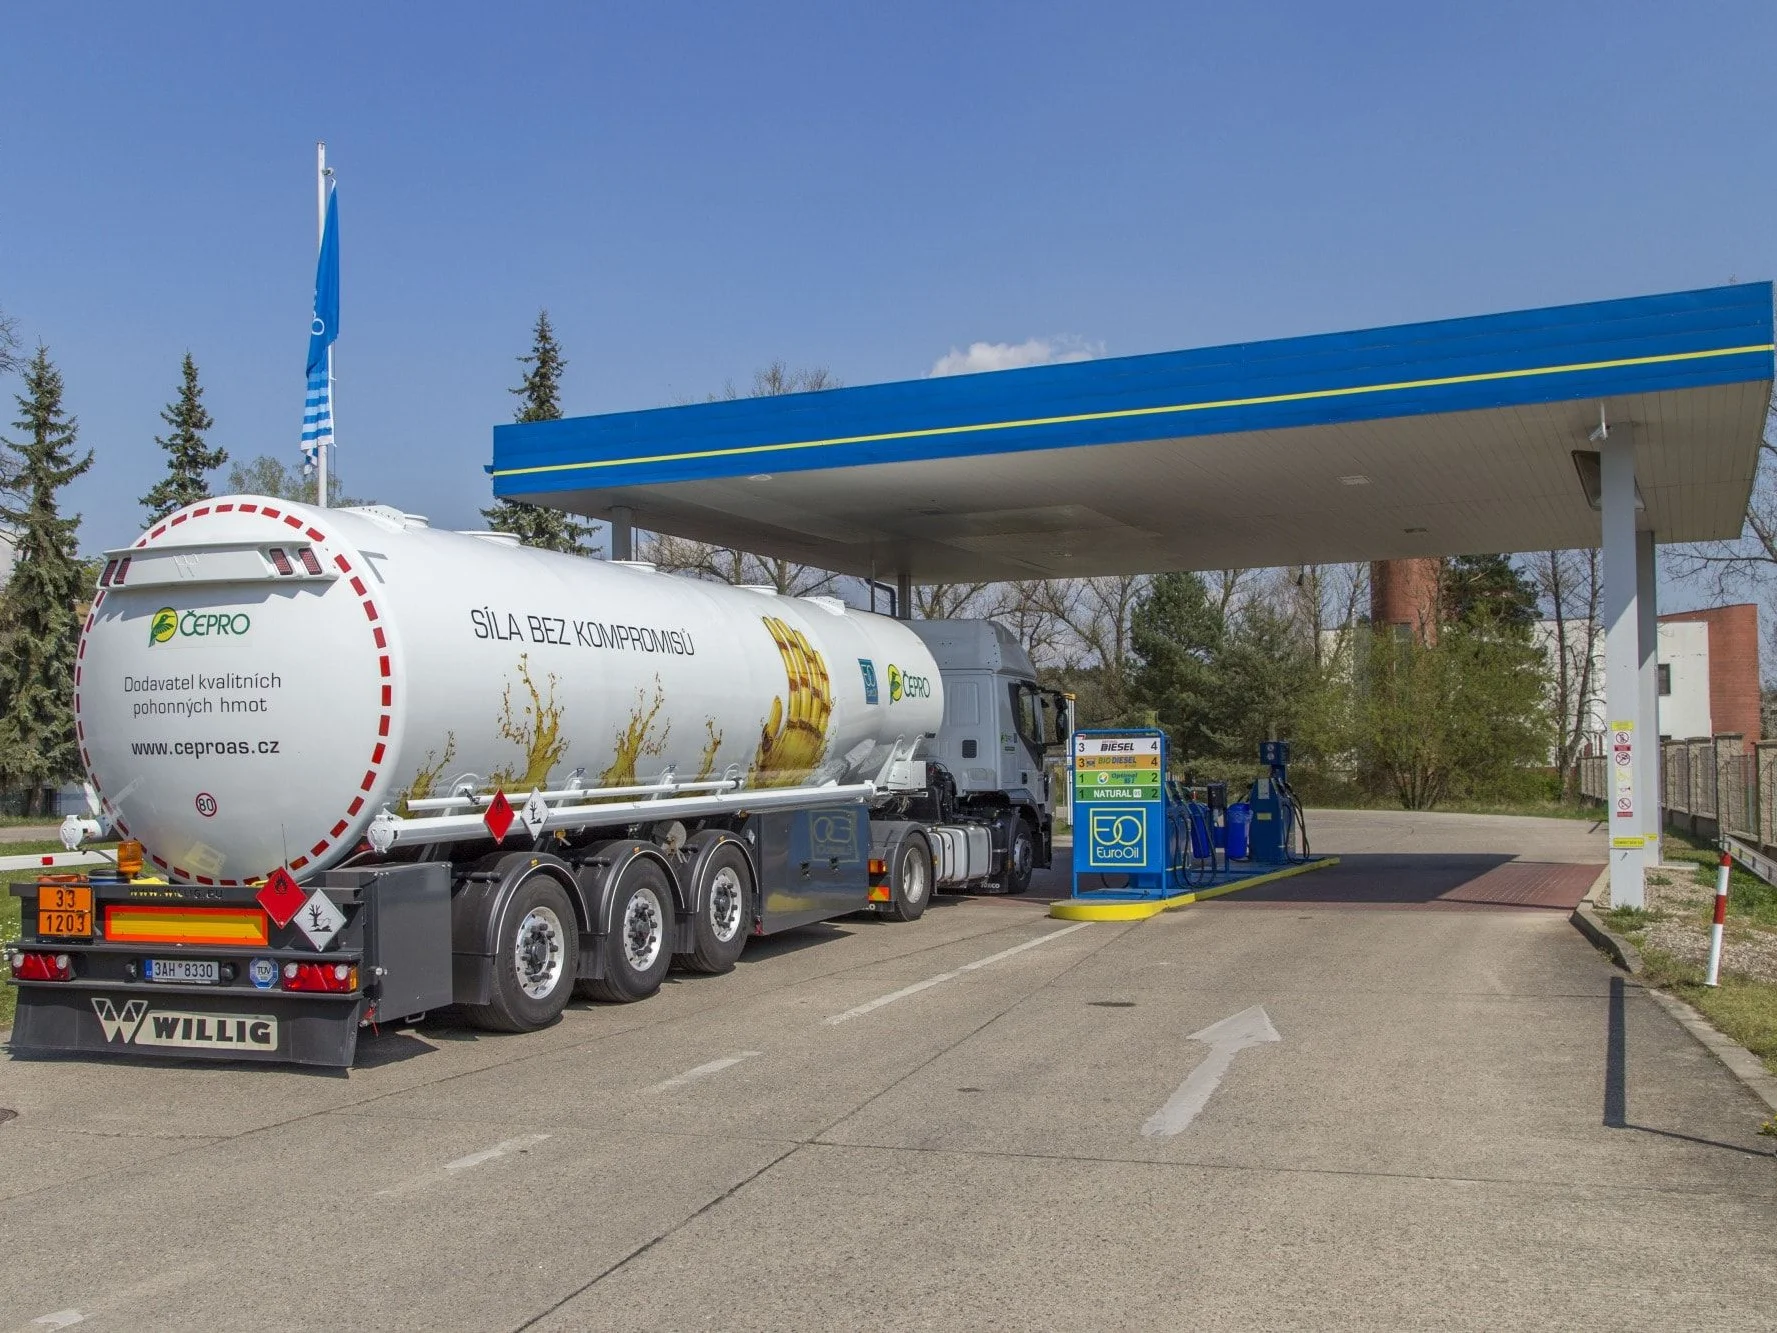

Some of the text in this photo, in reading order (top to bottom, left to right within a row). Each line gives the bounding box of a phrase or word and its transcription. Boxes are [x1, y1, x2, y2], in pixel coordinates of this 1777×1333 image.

[180, 610, 251, 637] ČEPRO
[470, 606, 695, 656] SÍLA BEZ KOMPROMISŮ
[124, 672, 281, 692] Dodavatel kvalitních
[902, 670, 931, 698] ČEPRO
[133, 697, 267, 719] pohonných hmot
[131, 740, 280, 759] www.ceproas.cz
[1078, 742, 1085, 752] 3
[1150, 741, 1158, 751] 4
[1078, 757, 1085, 768] 3
[1151, 757, 1158, 766] 4
[1079, 773, 1084, 783] 1
[1151, 772, 1158, 783] 2
[1079, 789, 1084, 799] 1
[1093, 789, 1132, 798] NATURAL
[1151, 789, 1158, 798] 2
[1096, 846, 1139, 858] EuroOil
[56, 890, 75, 908] 33
[47, 914, 85, 932] 1203
[155, 962, 175, 977] 3AH
[184, 963, 213, 977] 8330
[153, 1016, 271, 1045] WILLIG
